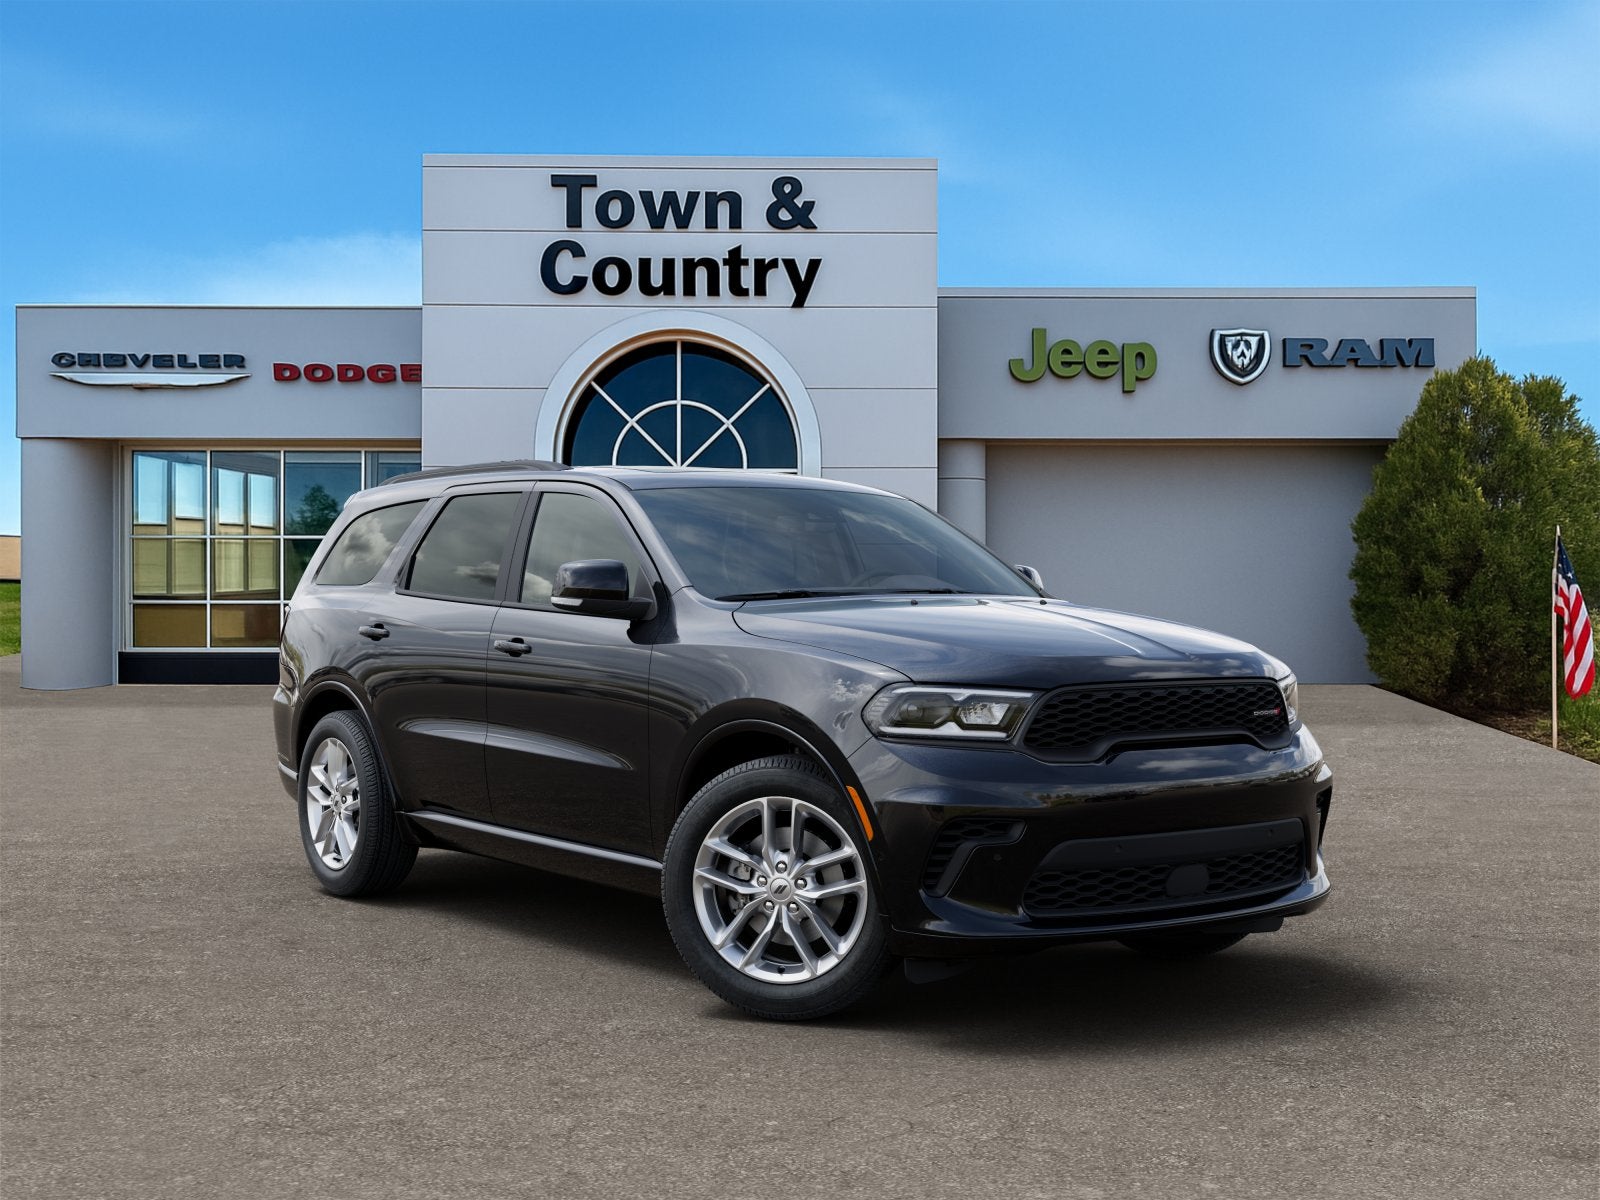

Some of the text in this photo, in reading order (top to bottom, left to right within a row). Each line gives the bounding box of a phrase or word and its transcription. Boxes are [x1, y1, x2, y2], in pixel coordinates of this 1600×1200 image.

[550, 174, 818, 230] Town &
[540, 239, 822, 308] Country
[273, 363, 422, 382] DODGE
[1009, 328, 1157, 392] Jeep
[1283, 337, 1435, 367] RAM
